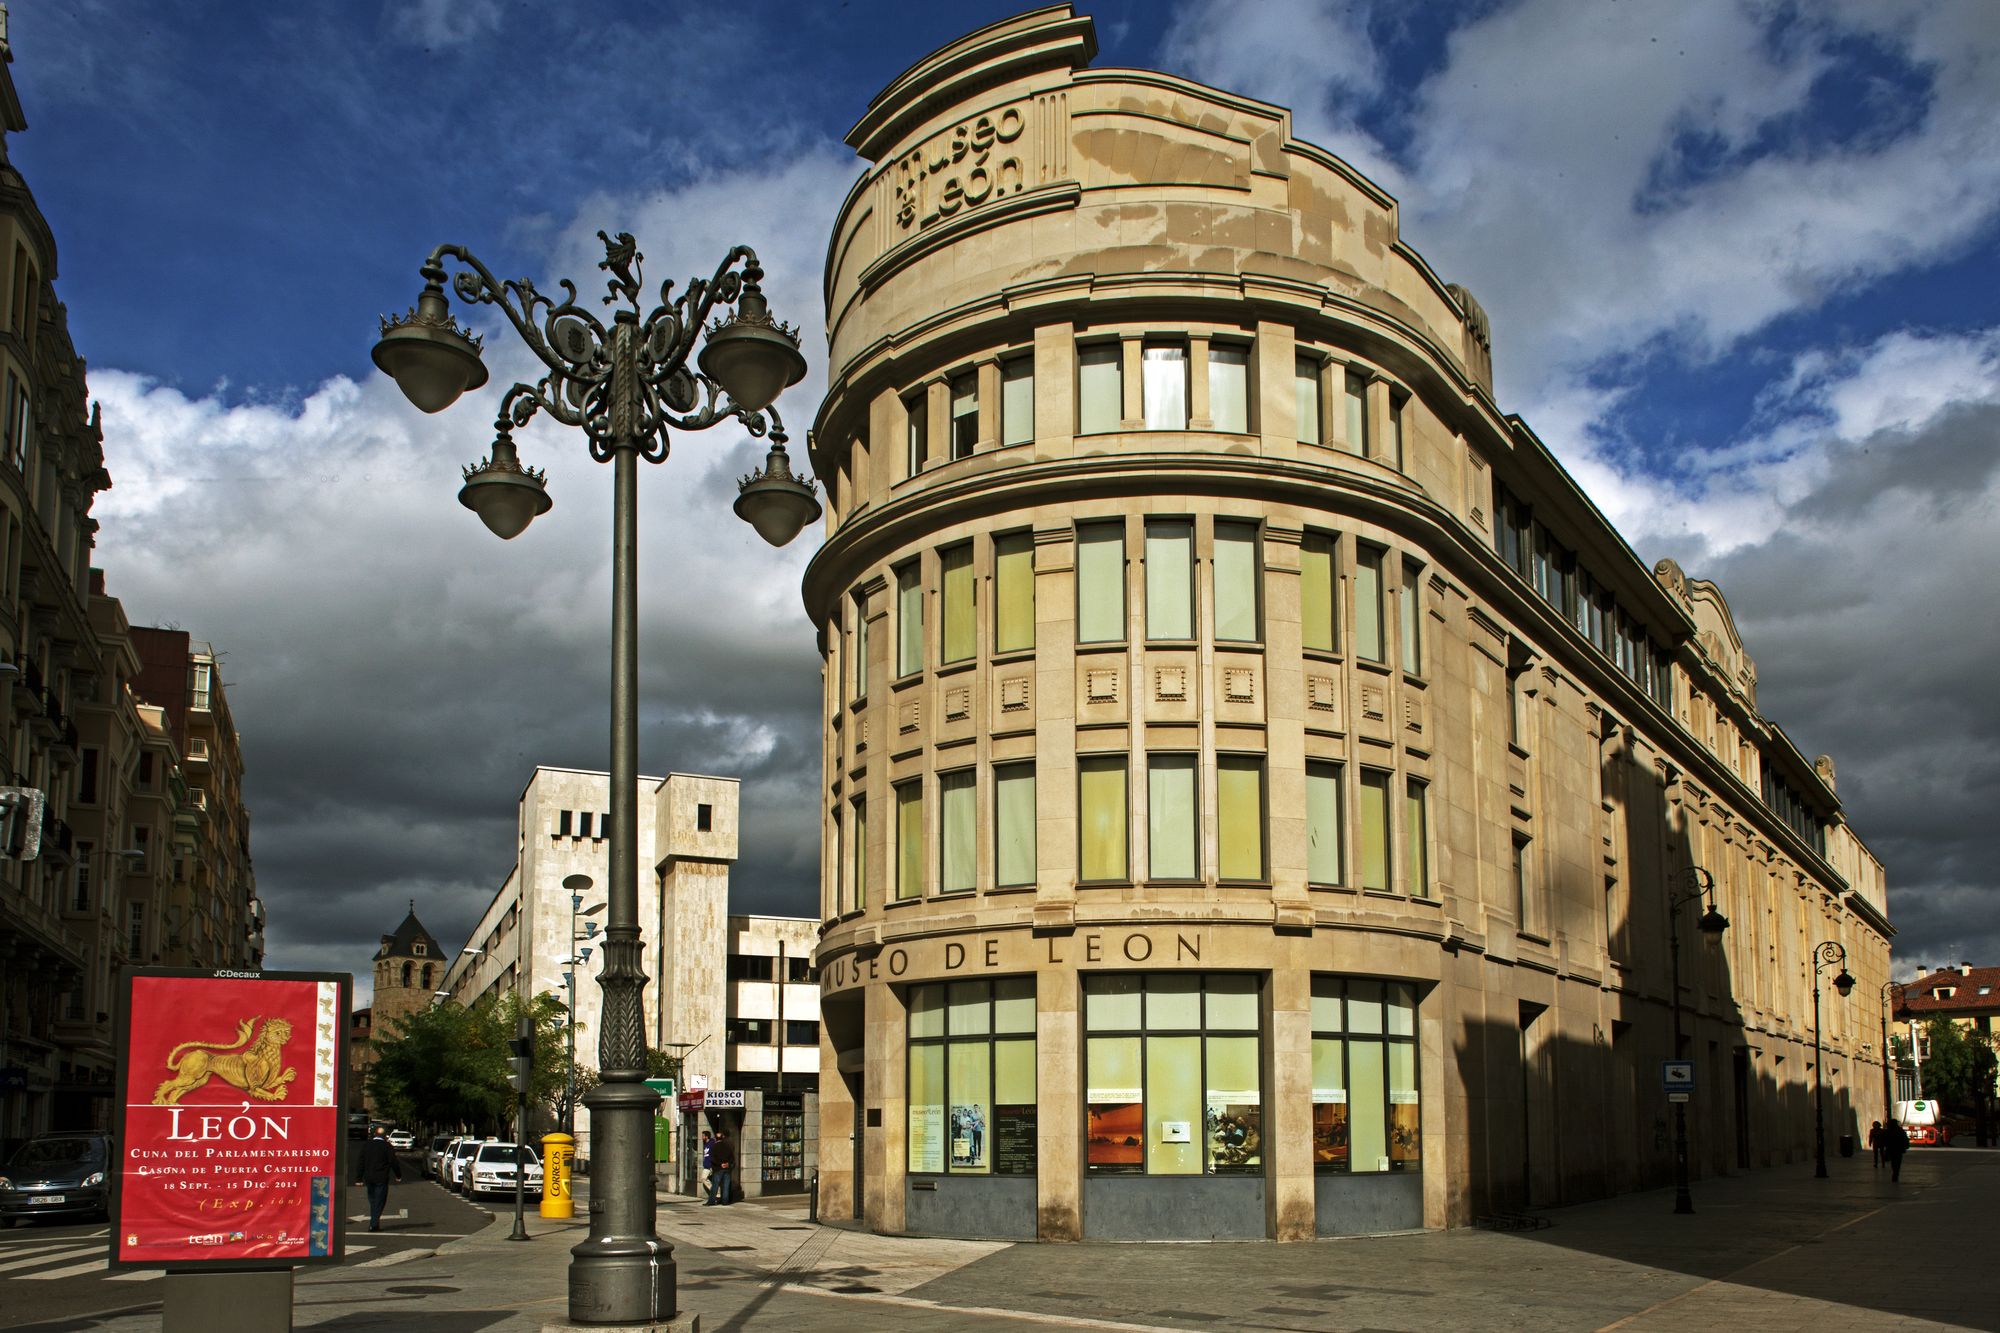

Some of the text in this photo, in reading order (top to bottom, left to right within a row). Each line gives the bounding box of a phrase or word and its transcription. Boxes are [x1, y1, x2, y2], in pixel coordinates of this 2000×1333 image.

[824, 932, 1202, 993] MUSEO DE LEON
[213, 969, 261, 979] JCDecaux
[707, 1091, 742, 1099] KIOSCO
[130, 1148, 330, 1158] CUNA DEL PARLAMENTARISMO
[192, 1166, 206, 1174] DE
[214, 1165, 258, 1174] PUERTA
[550, 1151, 560, 1197] CORREOS
